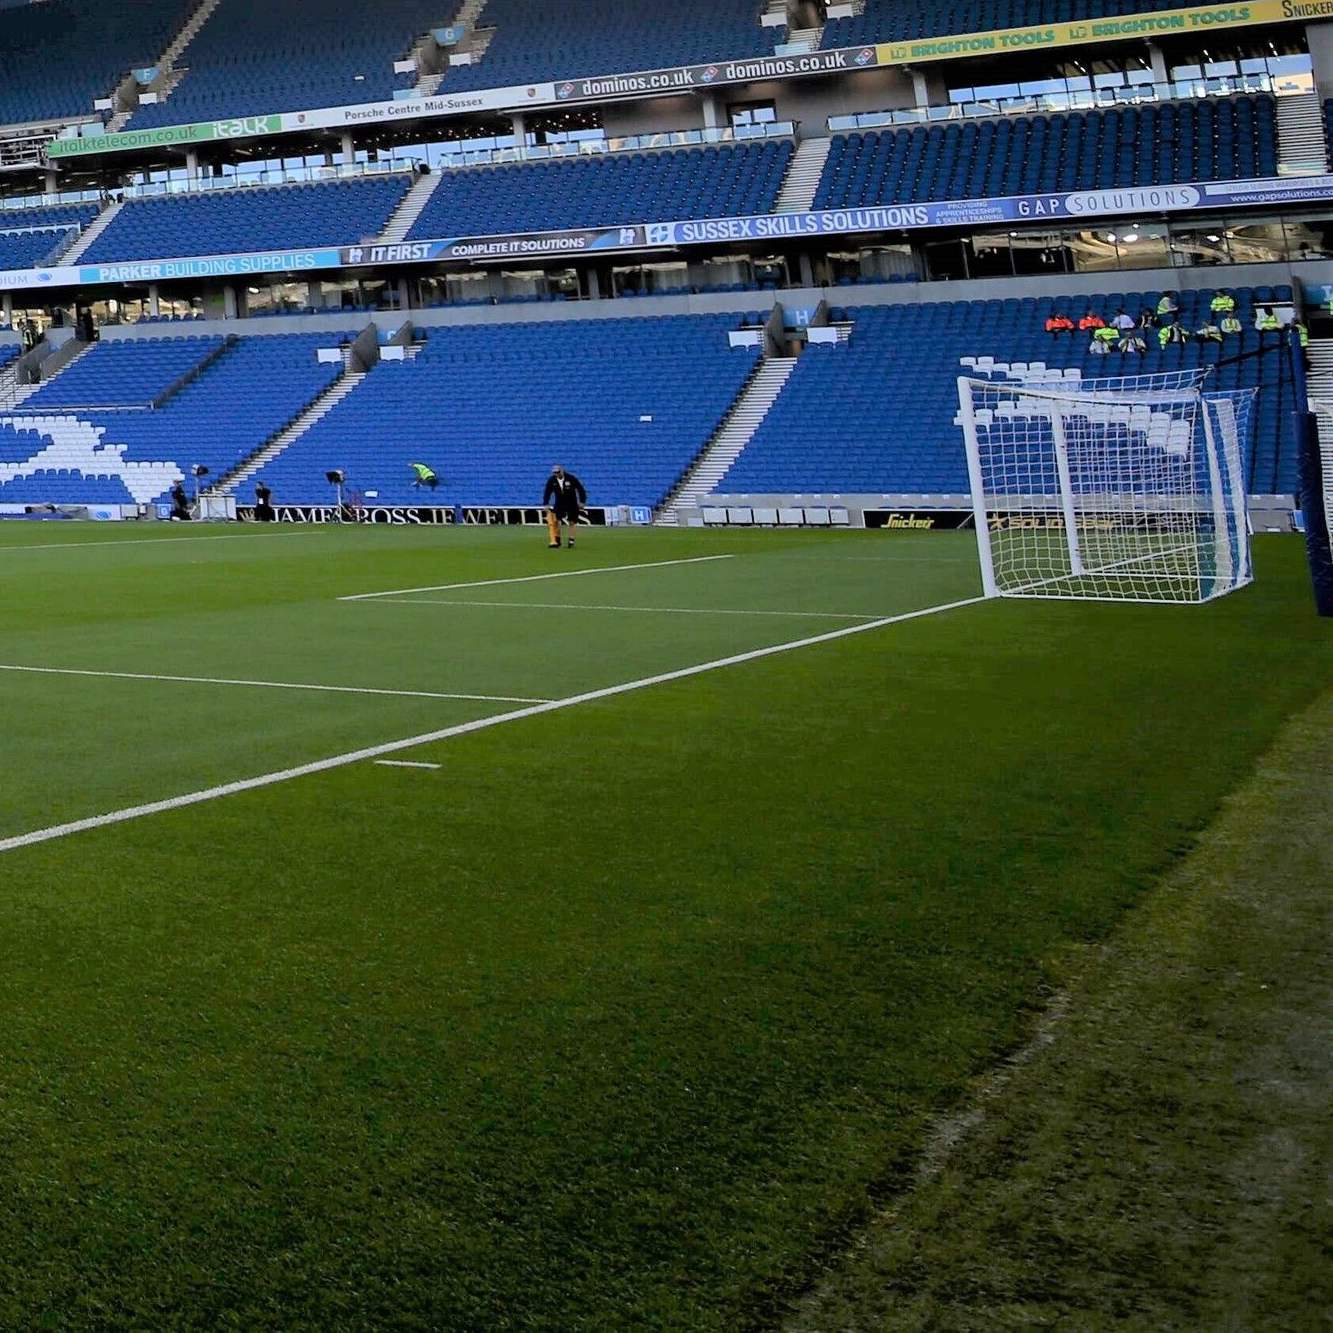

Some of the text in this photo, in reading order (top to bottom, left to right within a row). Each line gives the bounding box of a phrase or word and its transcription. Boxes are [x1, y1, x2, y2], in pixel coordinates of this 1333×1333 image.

[1091, 13, 1185, 36] BRIGHTON
[1189, 7, 1251, 27] TOOLS
[911, 36, 995, 57] BRIGHTON
[999, 30, 1055, 47] TOOLS
[143, 69, 150, 79] F
[726, 51, 846, 80] dominos.co.uk
[582, 68, 694, 96] dominos.co.uk
[345, 97, 483, 120] Porsche Centre Mid-Sussex
[59, 126, 197, 154] italktelecom.co.uk
[1018, 189, 1191, 216] GAP SOLUTIONS
[683, 206, 929, 241] SUSSEX SKILLS SOLUTIONS
[370, 244, 431, 262] IT FIRST
[452, 237, 584, 256] COMPLETE IT SOLUTIONS
[99, 254, 315, 281] PARKER BUILDING SUPPLIES
[795, 310, 809, 325] H
[635, 510, 644, 520] H
